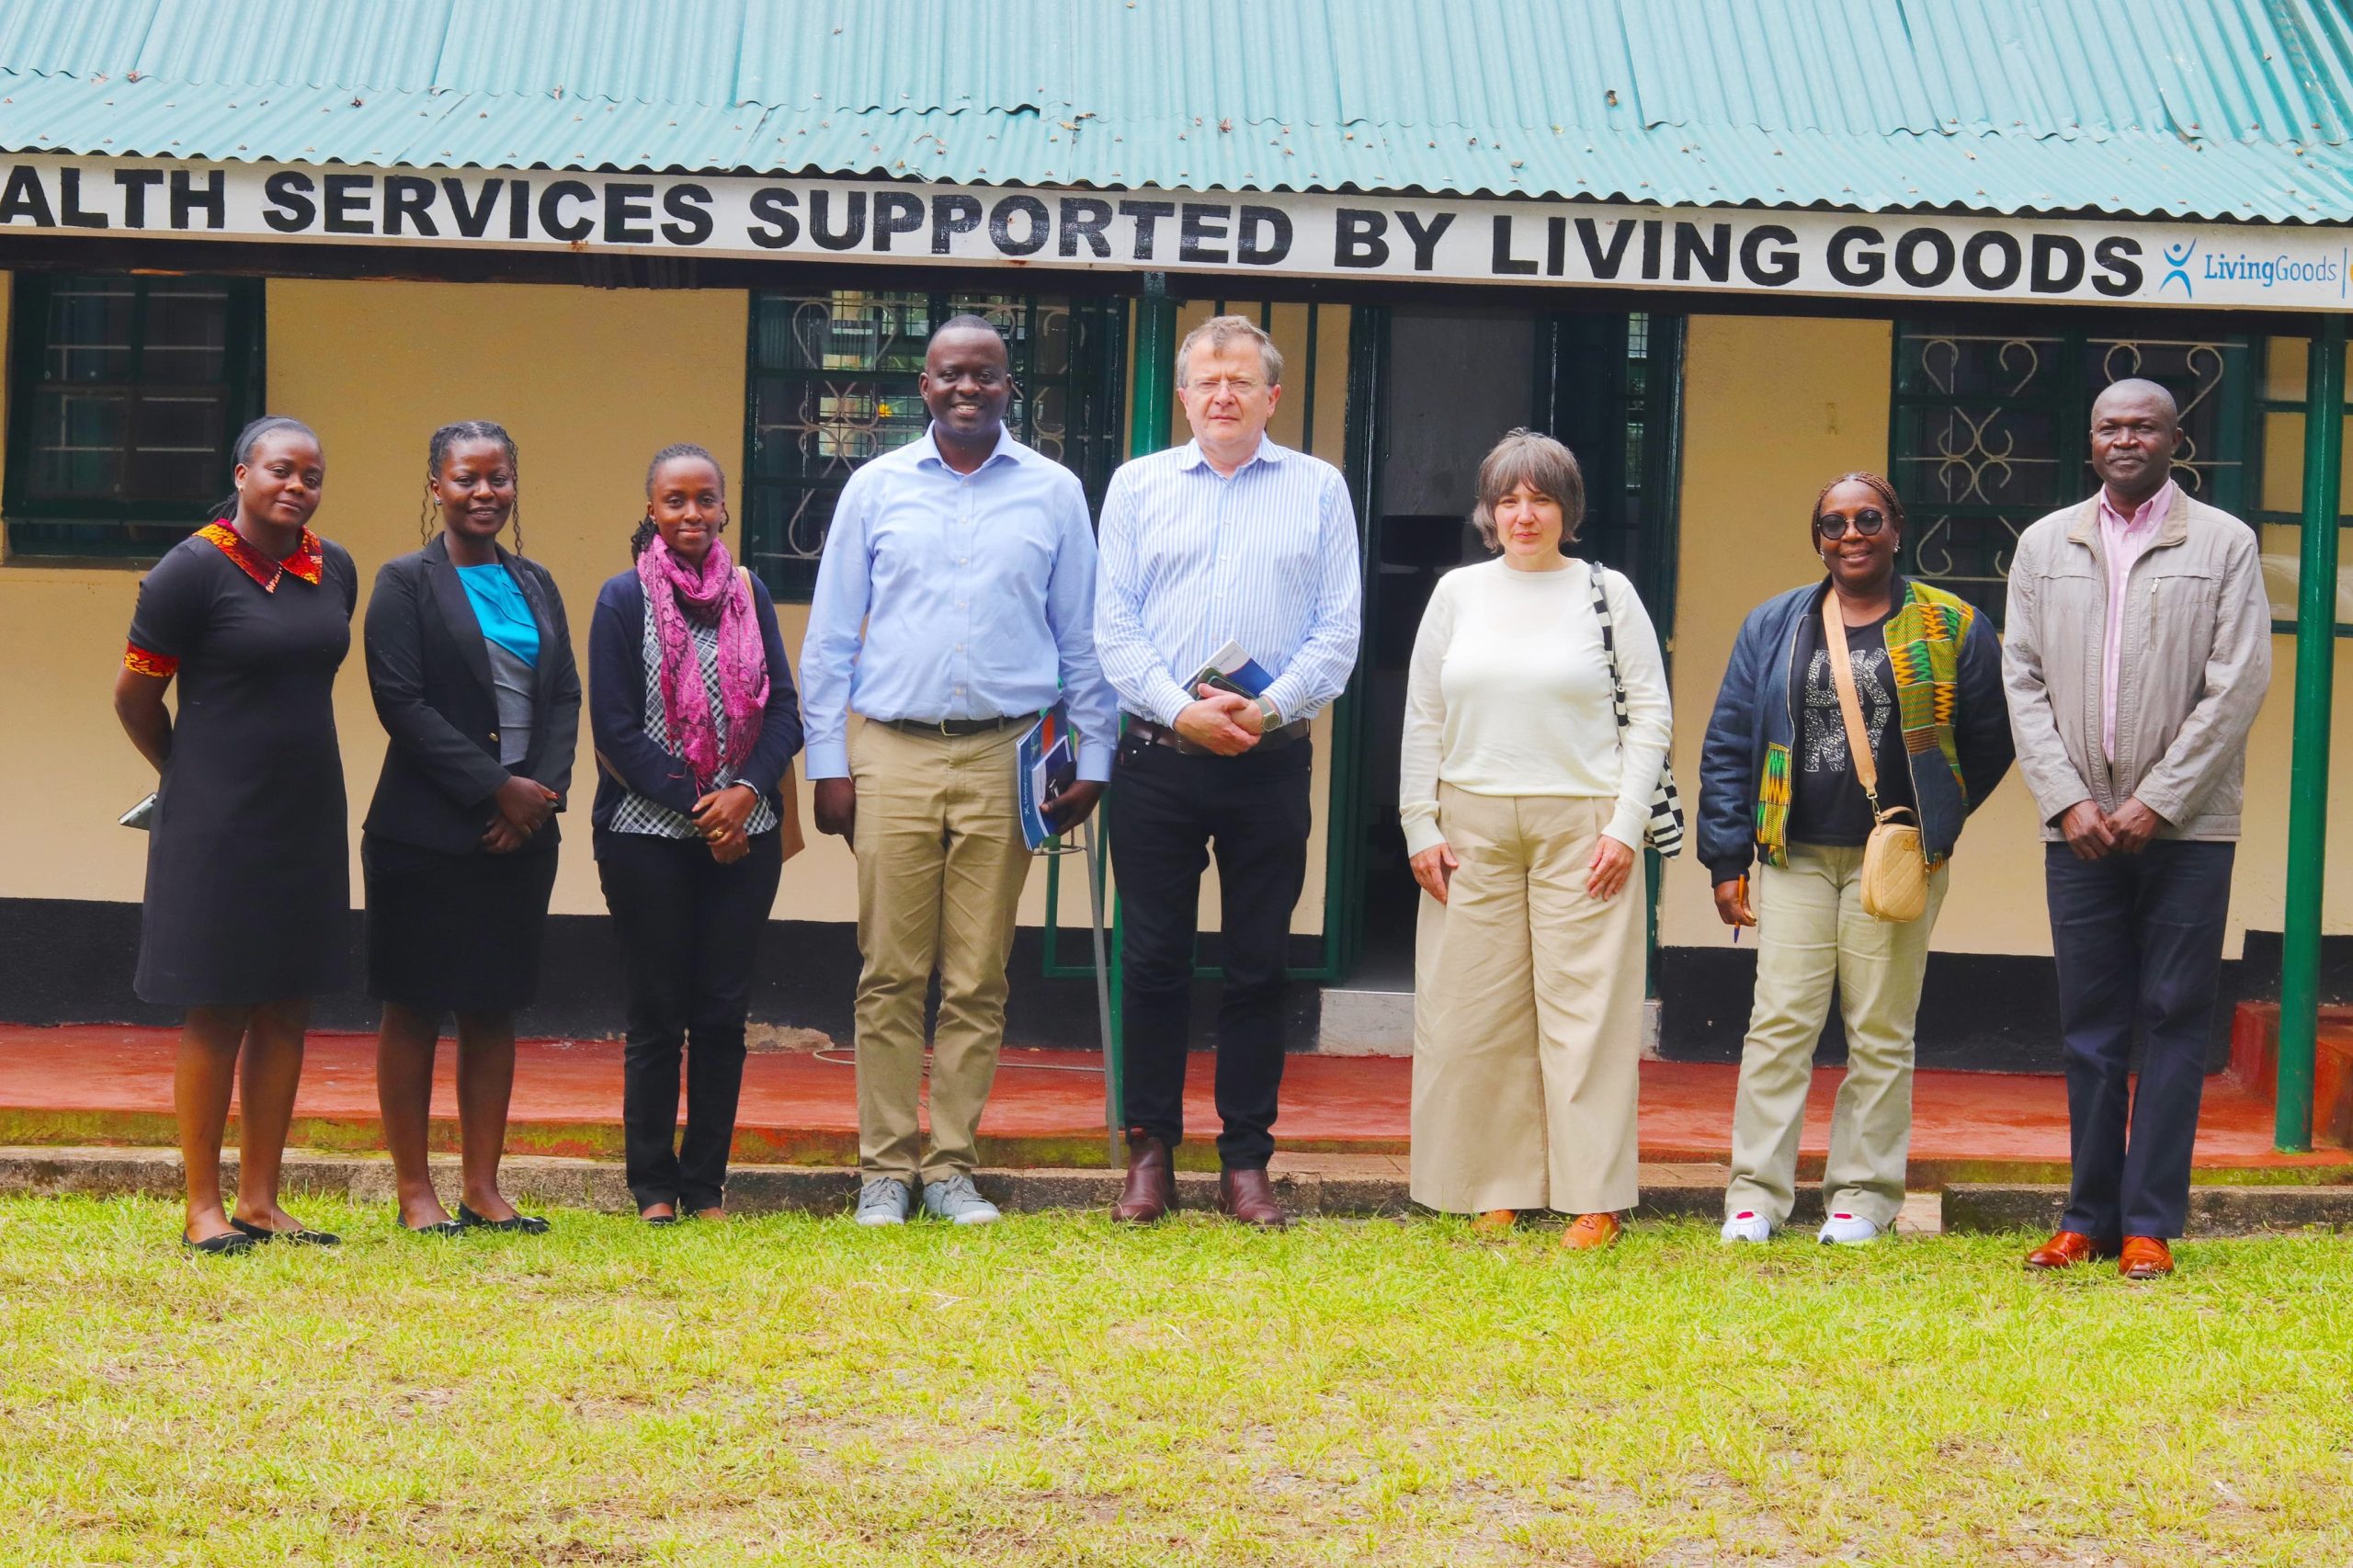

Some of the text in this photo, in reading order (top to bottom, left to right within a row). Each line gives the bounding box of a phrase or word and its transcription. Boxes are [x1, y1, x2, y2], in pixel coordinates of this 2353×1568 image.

[0, 165, 2143, 297] ALTH SERVICES SUPPORTED BY LIVING GOODS
[2204, 253, 2337, 288] LivingGoods
[1804, 647, 1892, 707] DK
